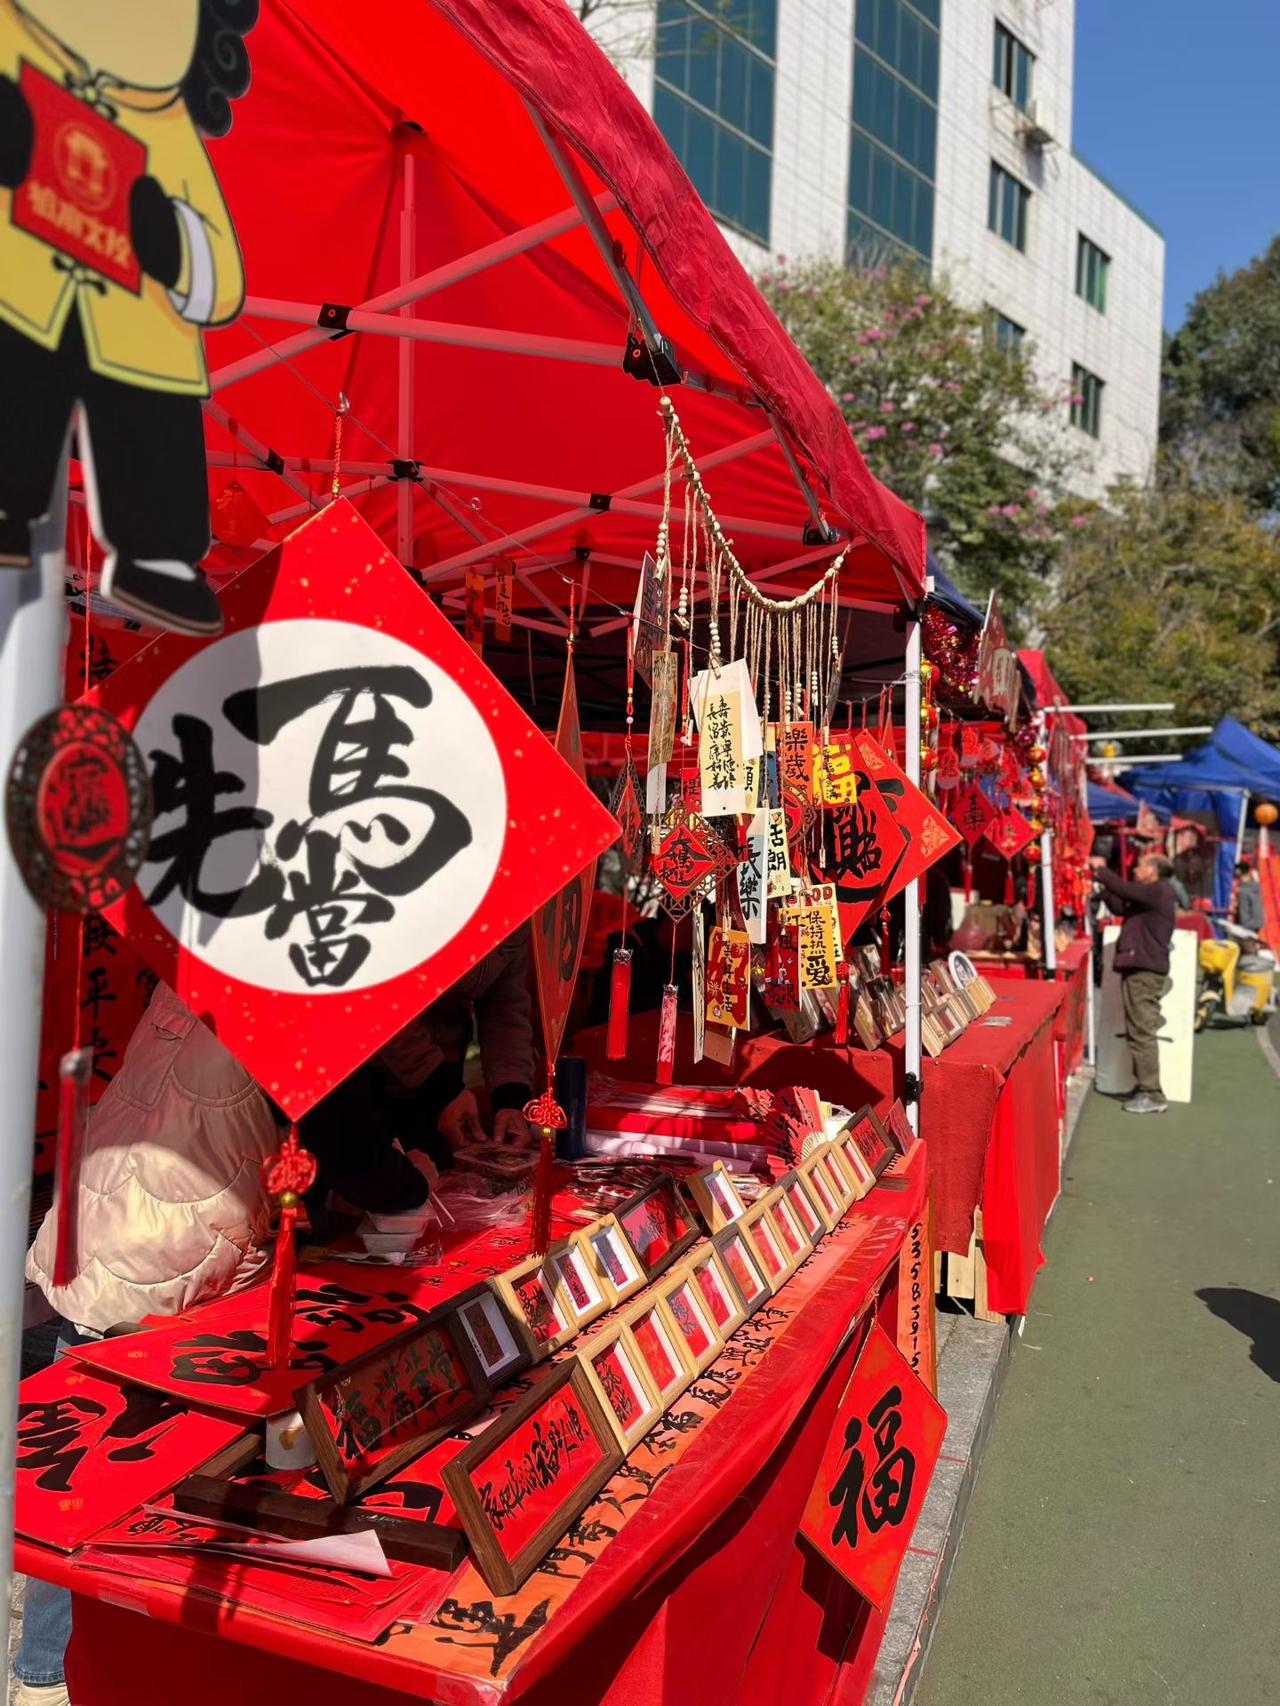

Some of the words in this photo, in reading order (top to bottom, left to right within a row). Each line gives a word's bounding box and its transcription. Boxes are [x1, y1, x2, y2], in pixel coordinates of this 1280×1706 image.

[804, 910, 833, 986] 保持热爱
[829, 1384, 916, 1550] 福
